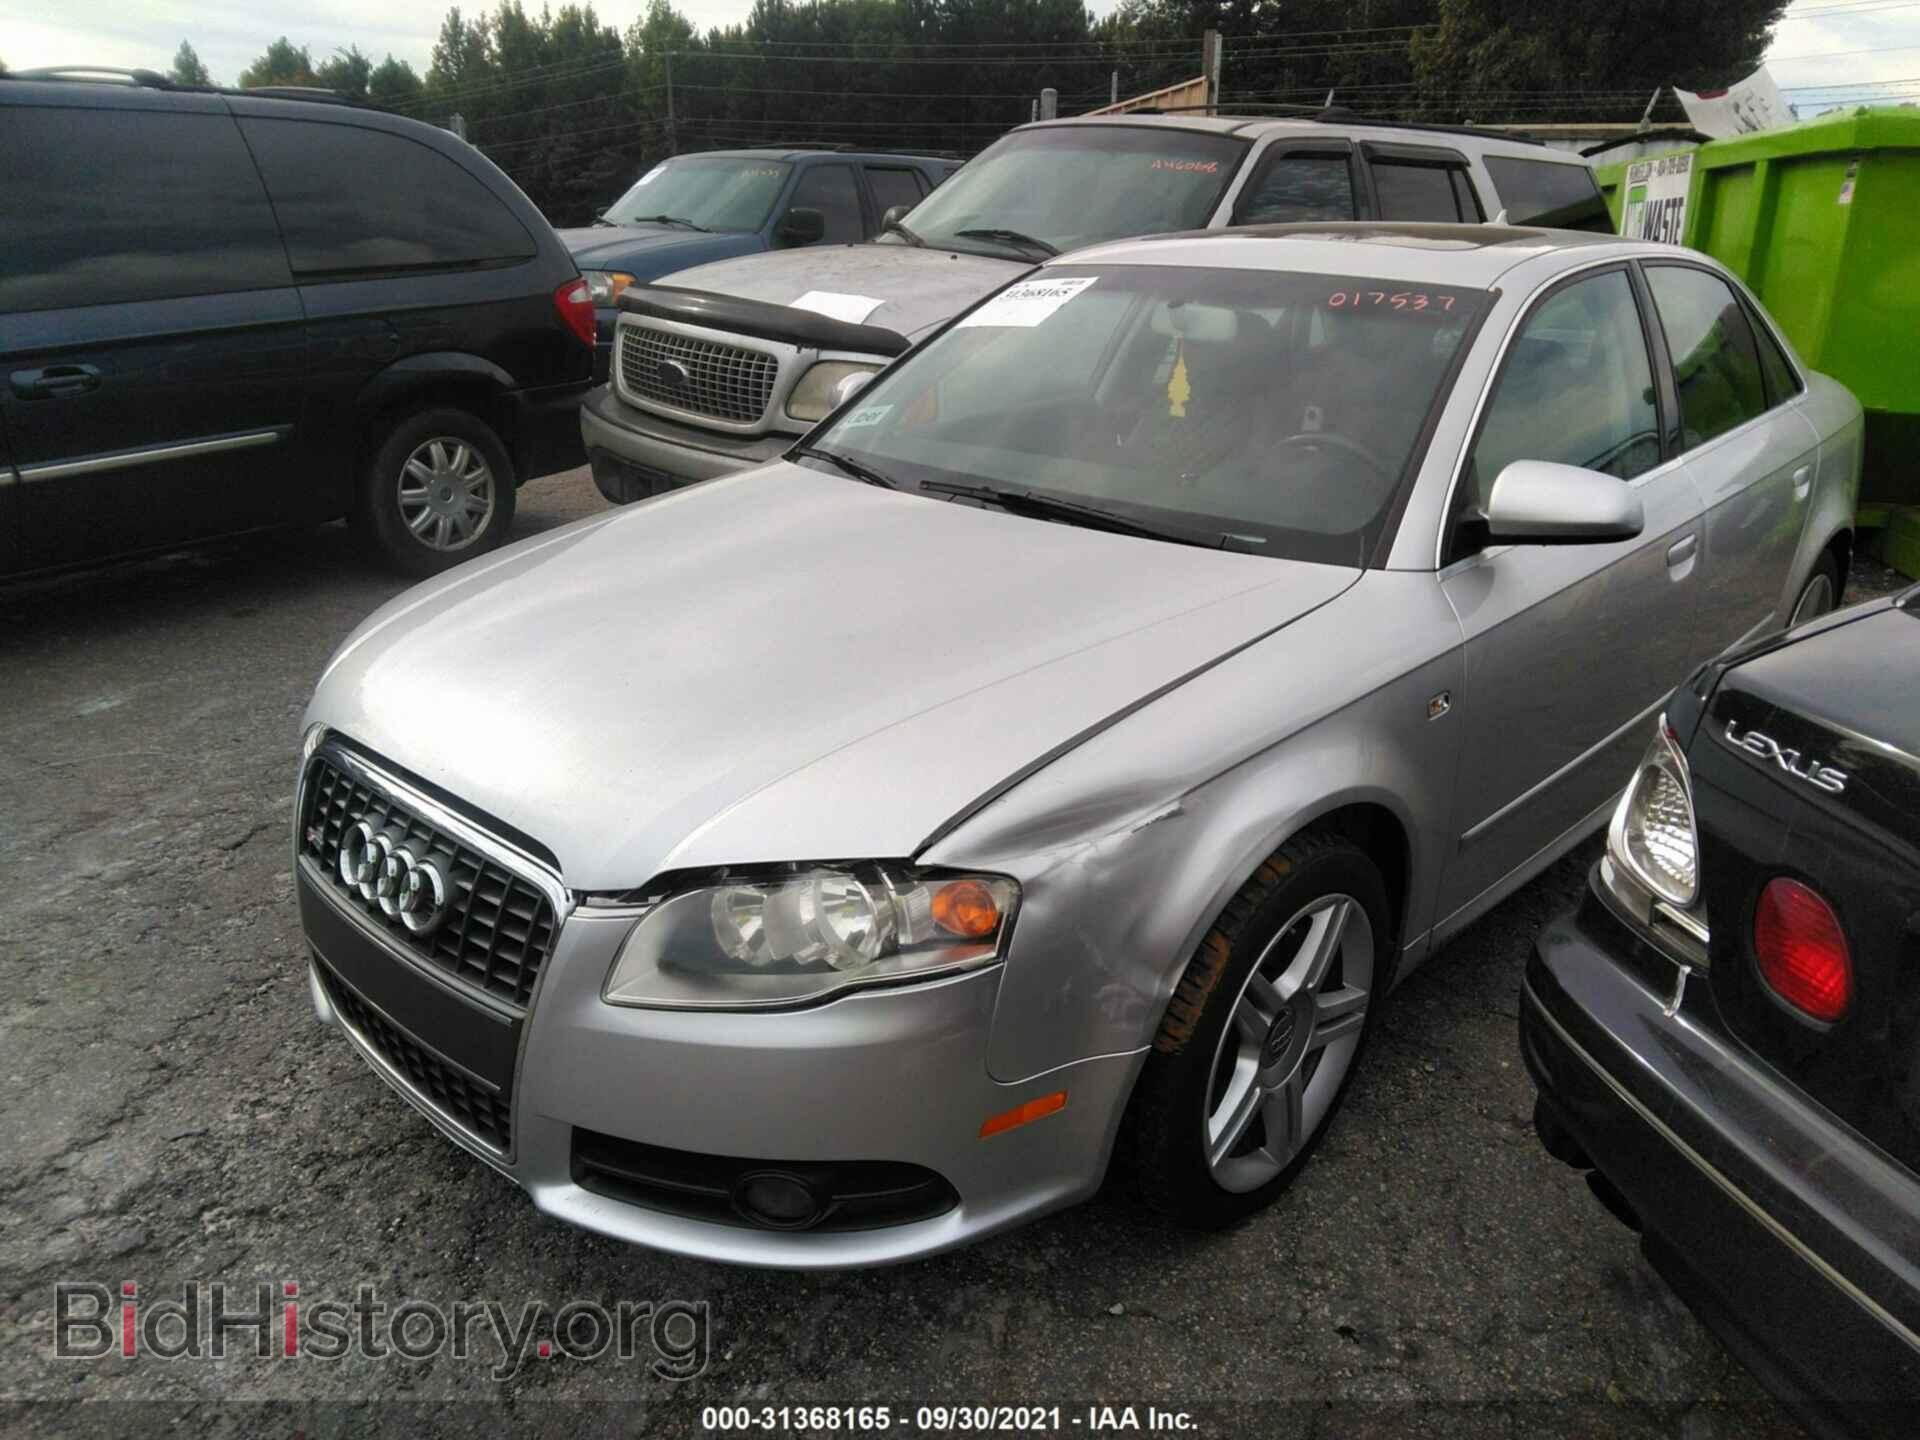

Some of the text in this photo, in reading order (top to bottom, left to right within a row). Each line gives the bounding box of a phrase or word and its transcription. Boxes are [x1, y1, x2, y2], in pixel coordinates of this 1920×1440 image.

[1643, 197, 1684, 245] WASTE
[1328, 292, 1455, 310] 017537
[1725, 719, 1848, 792] LEXUS
